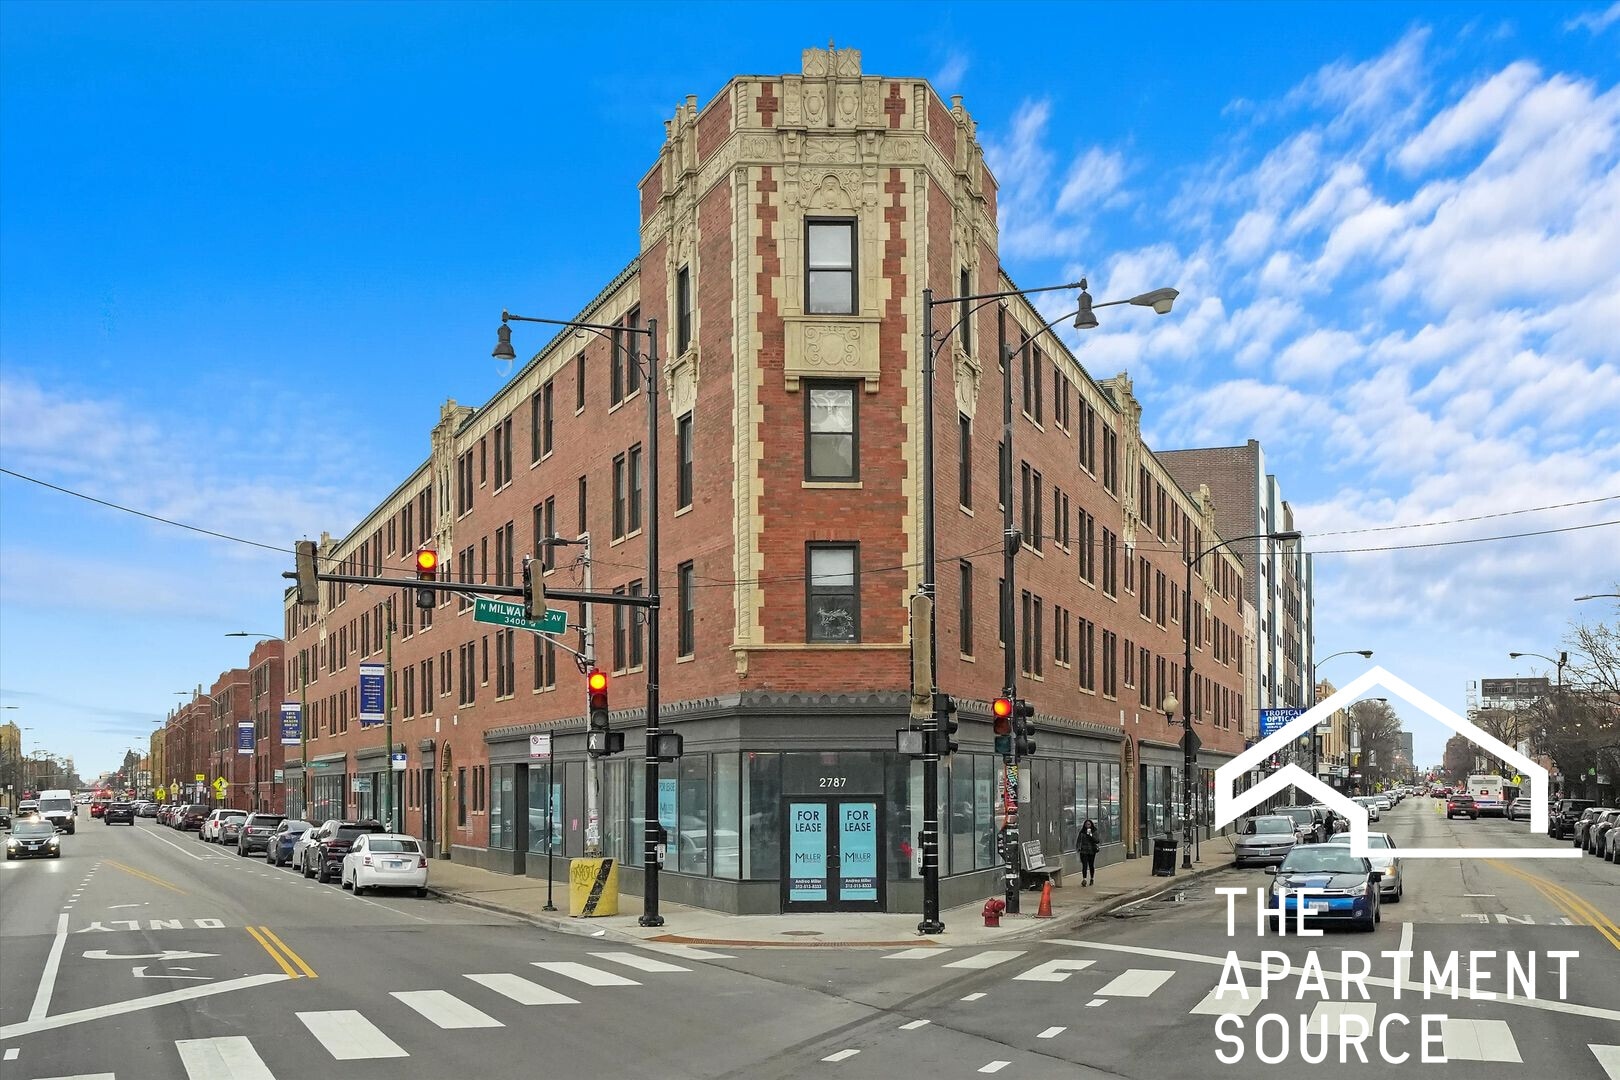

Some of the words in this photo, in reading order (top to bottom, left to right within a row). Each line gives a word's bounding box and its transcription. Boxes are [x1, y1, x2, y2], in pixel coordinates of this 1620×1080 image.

[488, 602, 550, 622] MILWAE
[551, 614, 562, 622] AV
[504, 616, 526, 626] 3400
[819, 777, 847, 788] 2787
[797, 811, 820, 821] FOR
[847, 810, 869, 821] FOR
[795, 823, 822, 832] LEASE
[844, 822, 871, 832] LEASE
[74, 918, 226, 933] ONLY
